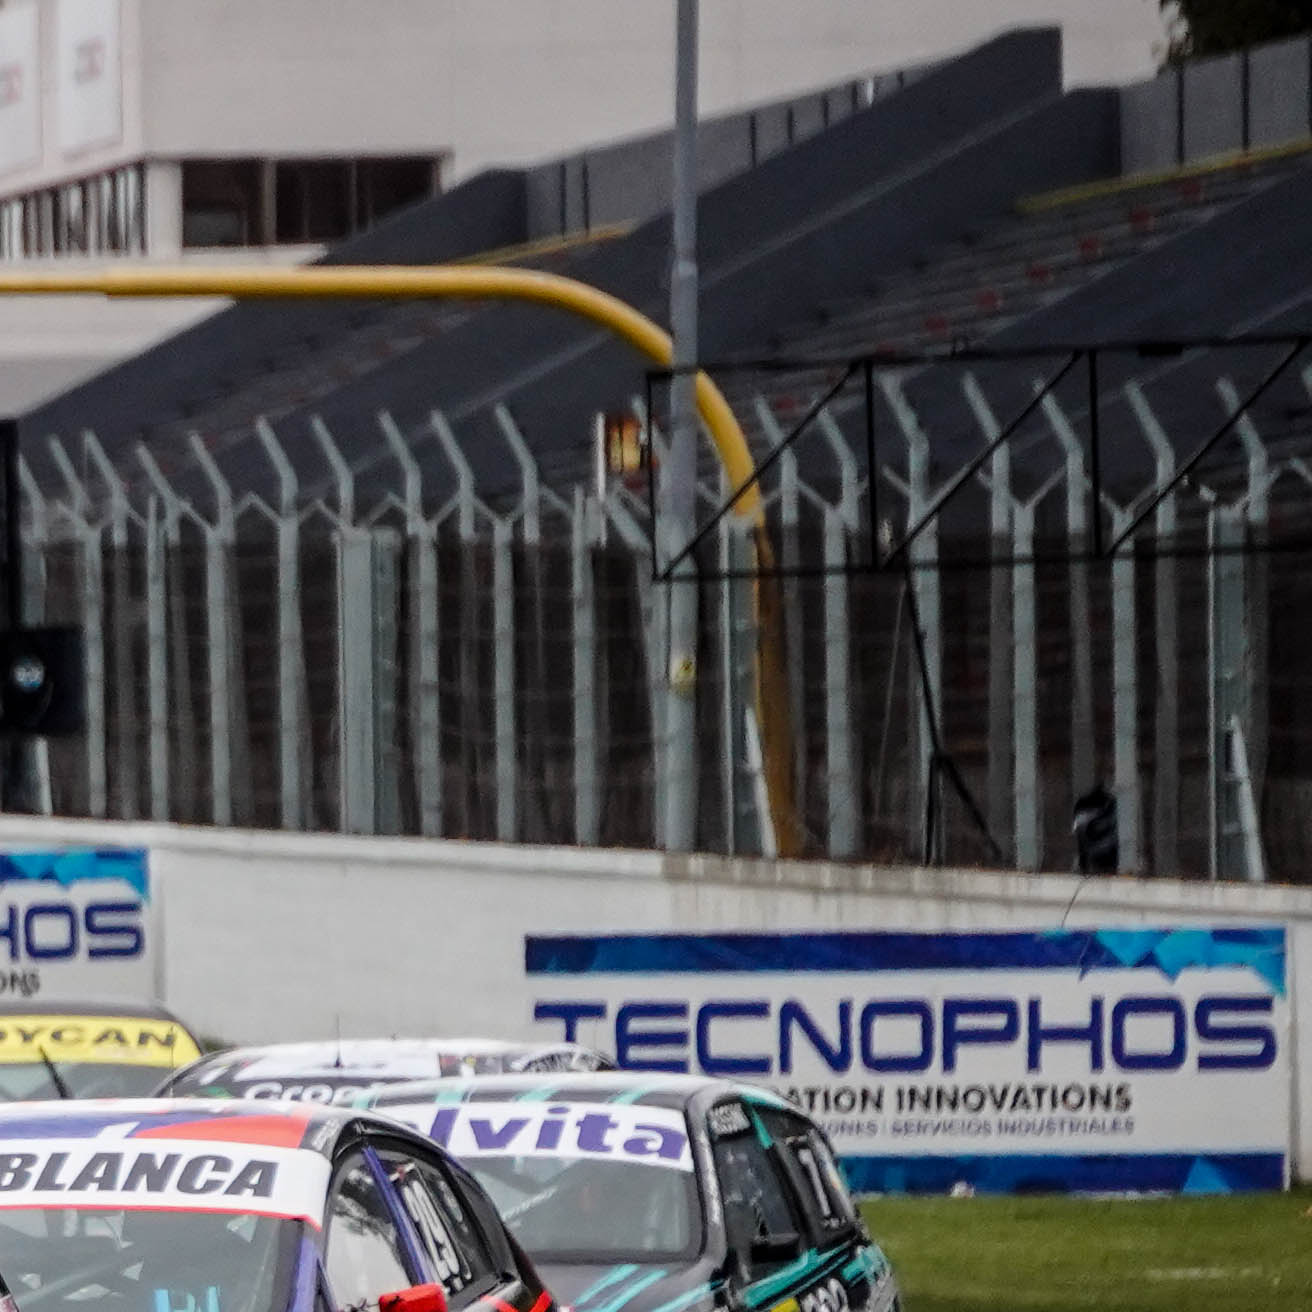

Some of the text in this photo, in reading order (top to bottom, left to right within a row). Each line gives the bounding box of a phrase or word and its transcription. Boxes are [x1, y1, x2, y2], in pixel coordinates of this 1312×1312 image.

[533, 995, 1279, 1076] TECNOPHOS
[895, 1081, 1134, 1114] INNOVATIONS
[402, 1107, 688, 1163] lvita
